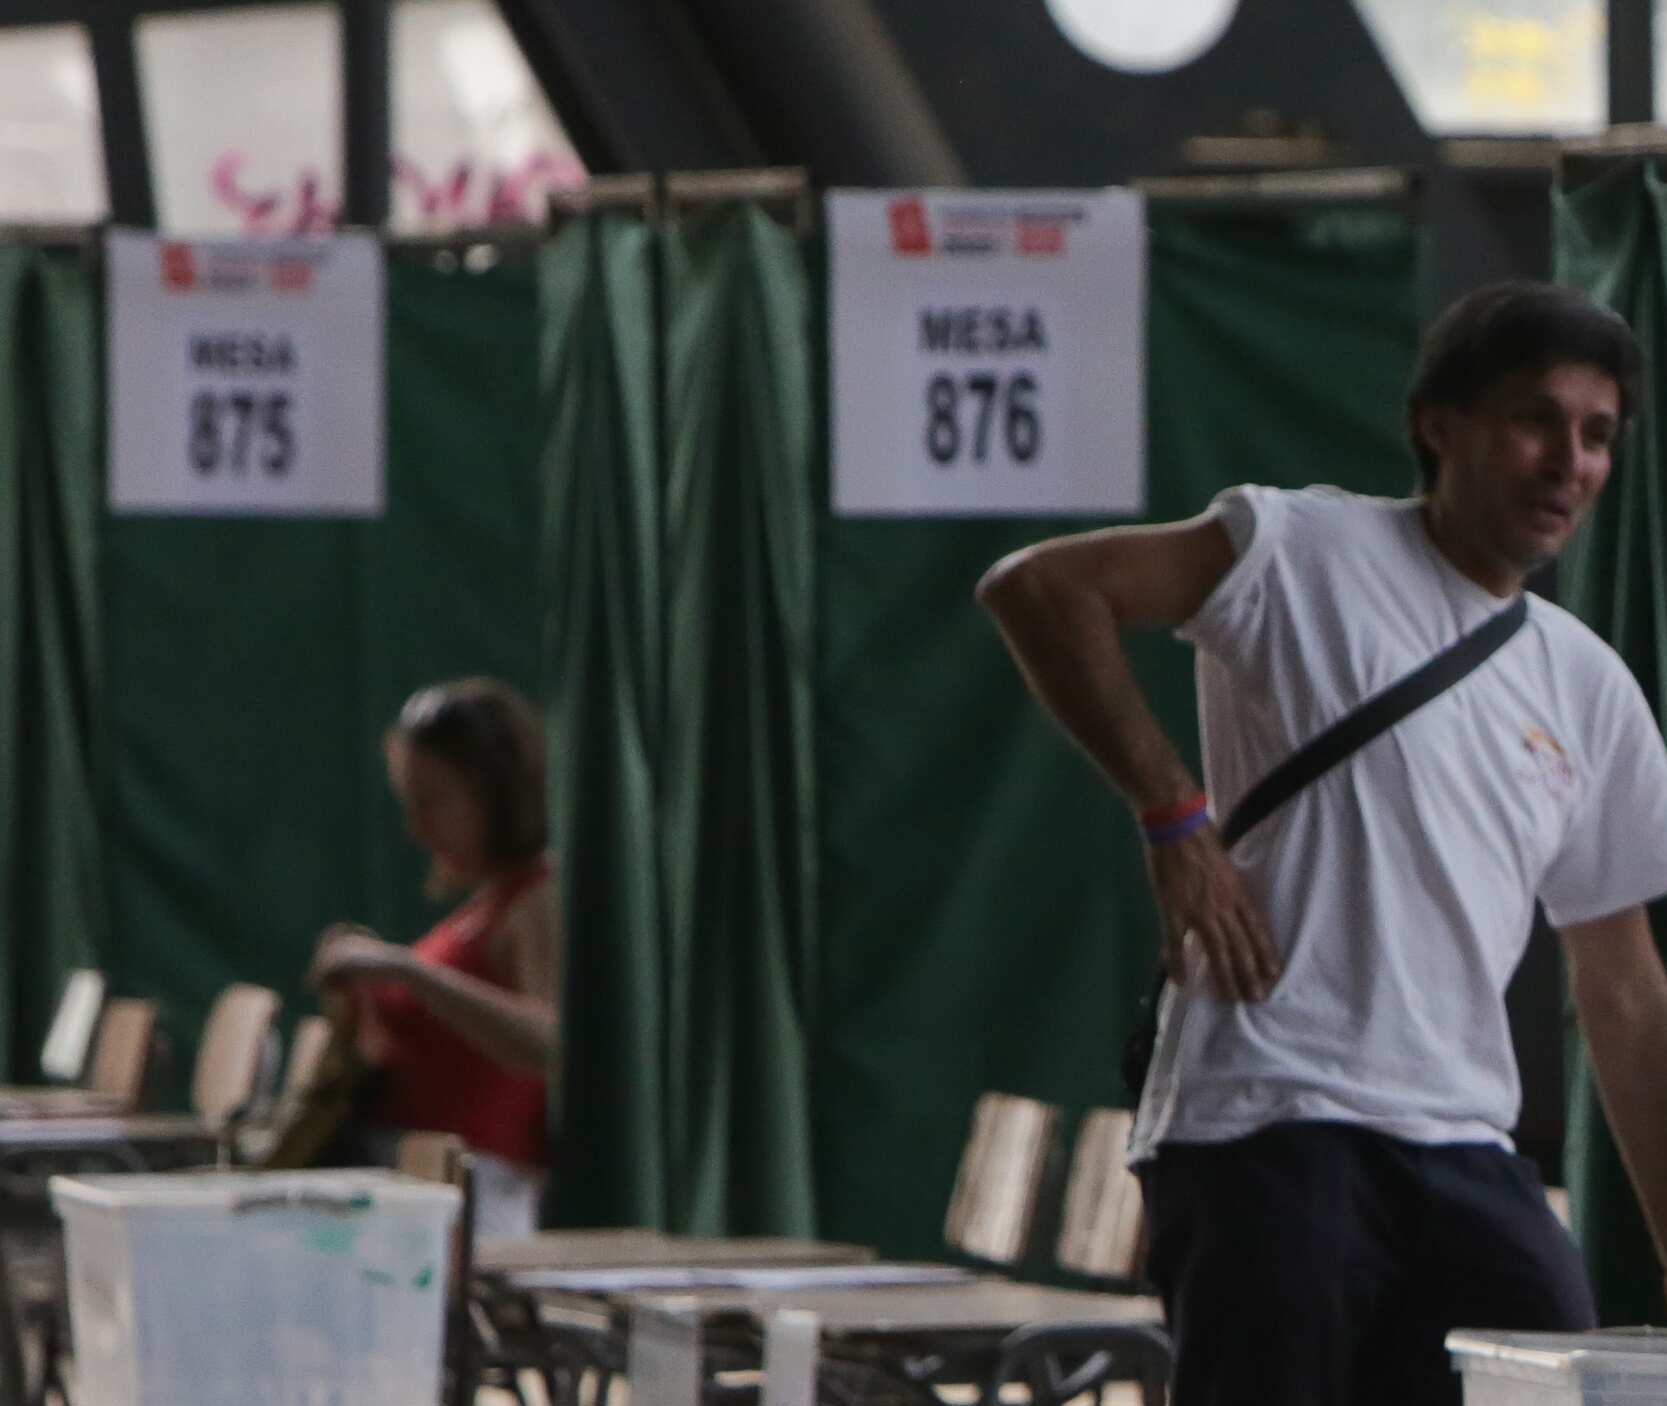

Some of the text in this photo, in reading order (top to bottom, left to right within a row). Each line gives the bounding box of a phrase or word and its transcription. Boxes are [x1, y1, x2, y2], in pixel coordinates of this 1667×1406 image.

[190, 333, 297, 375] MESA
[918, 307, 1048, 354] MESA
[189, 389, 297, 478] 875
[925, 370, 1042, 468] 876
